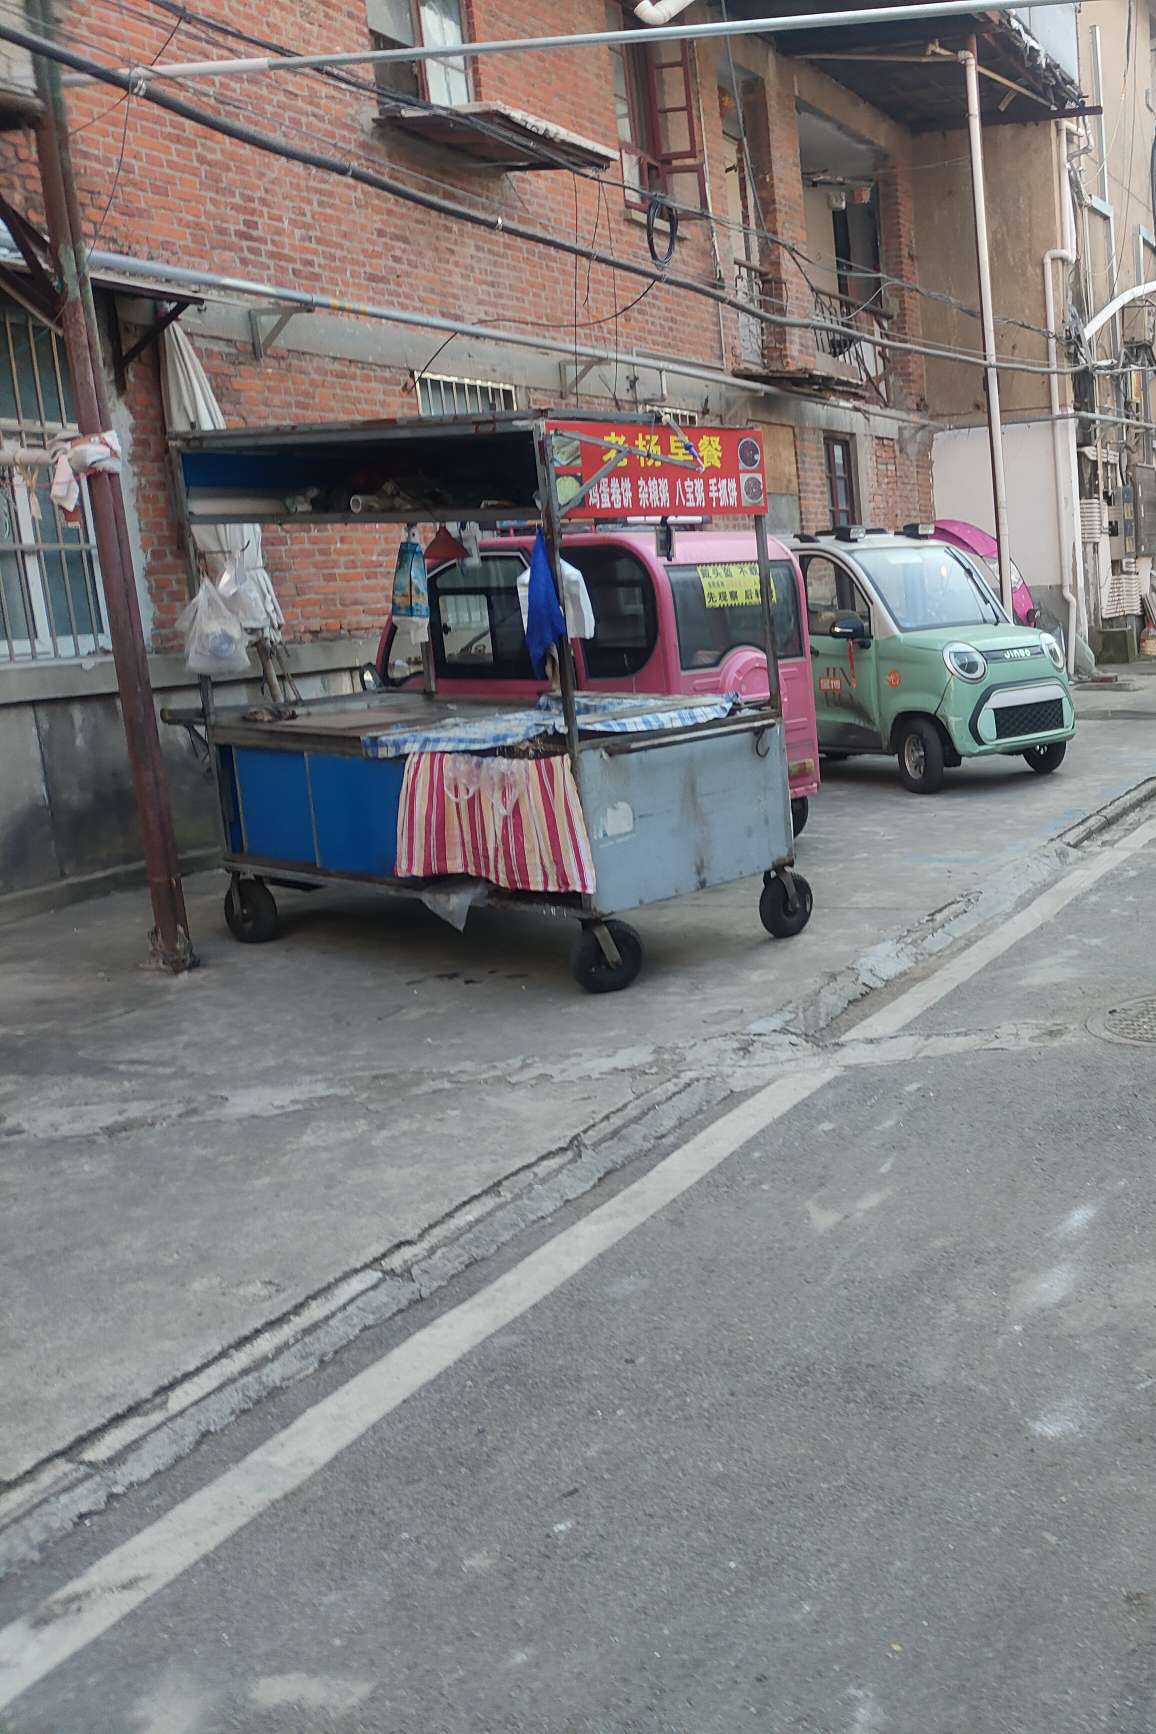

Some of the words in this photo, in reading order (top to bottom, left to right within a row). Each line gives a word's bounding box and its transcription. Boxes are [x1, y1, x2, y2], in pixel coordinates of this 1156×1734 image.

[601, 431, 723, 469] 老杨早餐
[588, 477, 633, 509] 鸡蛋卷饼
[637, 477, 669, 509] 杂粮粥
[675, 477, 706, 508] 八宝粥
[708, 477, 738, 508] 手抓饼
